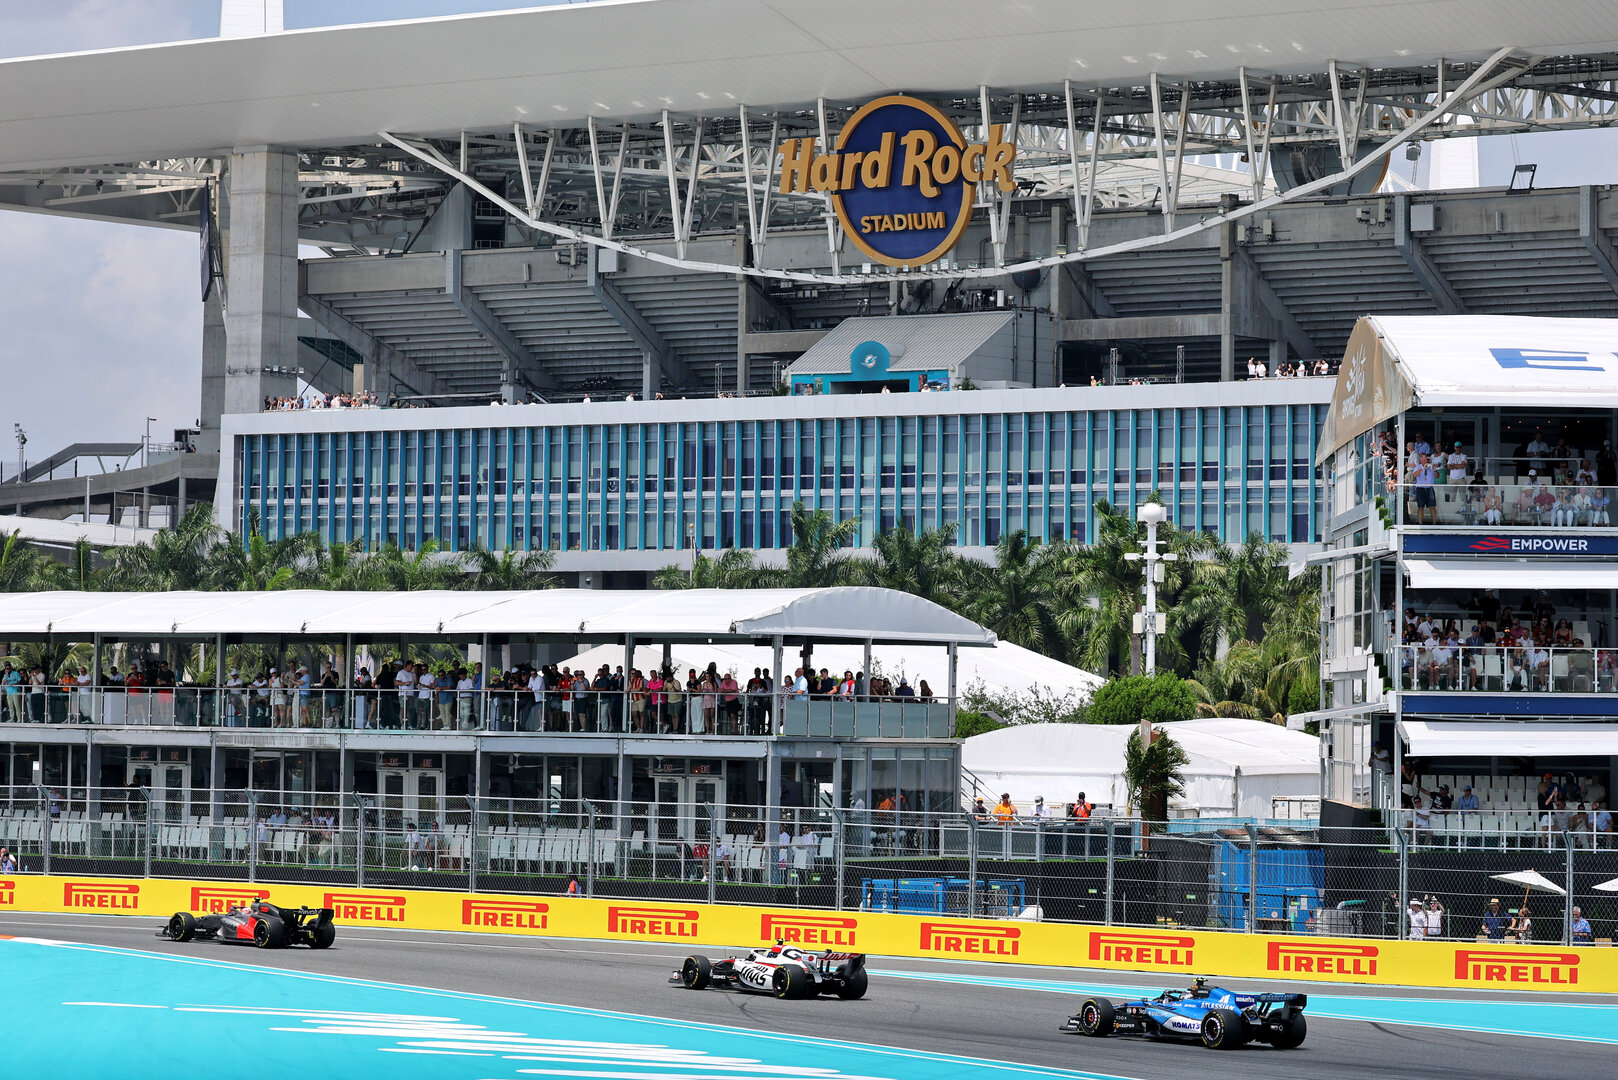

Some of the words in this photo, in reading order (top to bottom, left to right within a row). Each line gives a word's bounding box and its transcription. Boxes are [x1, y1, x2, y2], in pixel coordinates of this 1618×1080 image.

[778, 132, 896, 194] Hard
[901, 124, 1017, 198] Rock
[860, 212, 946, 234] STADIUM
[1511, 538, 1588, 551] EMPOWER
[64, 883, 139, 908] PIRELLI
[324, 893, 406, 921] PIRELLI
[463, 900, 549, 928] PIRELLI
[608, 907, 699, 936] PIRELLI
[761, 914, 857, 946] PIRELLI
[920, 923, 1020, 955] PIRELLI
[1089, 932, 1195, 965] PIRELLI
[1267, 942, 1378, 975] PIRELLI
[1455, 950, 1580, 983] PIRELLI
[1200, 1002, 1235, 1011] ATLASSIAN
[1172, 1022, 1201, 1030] KOMATS
